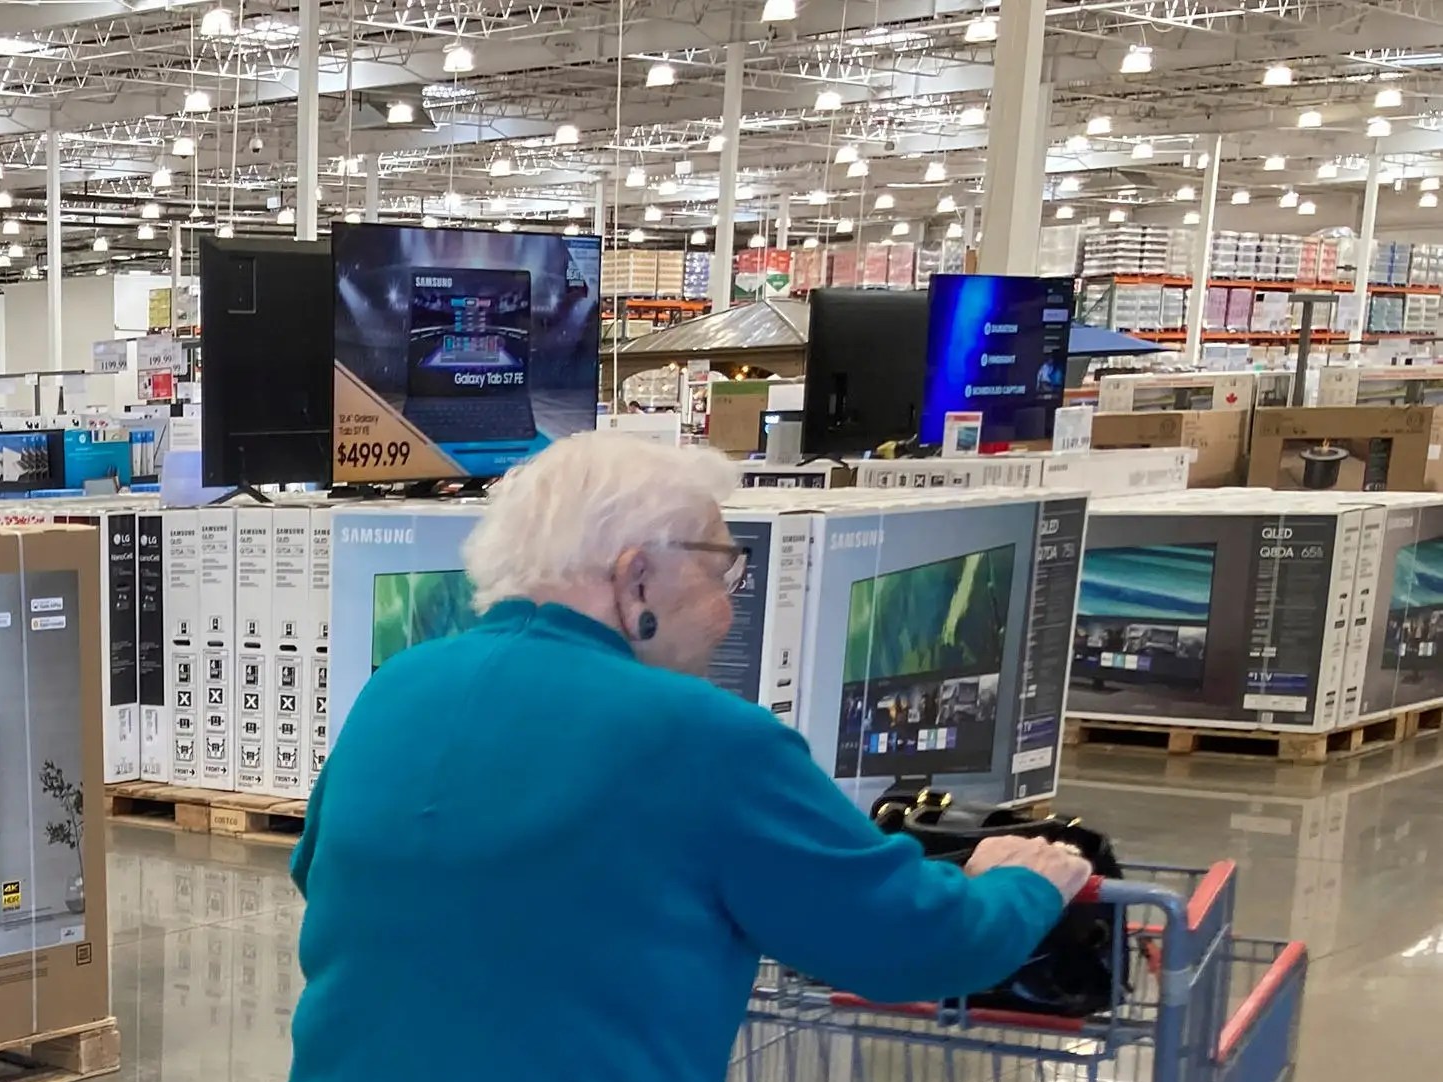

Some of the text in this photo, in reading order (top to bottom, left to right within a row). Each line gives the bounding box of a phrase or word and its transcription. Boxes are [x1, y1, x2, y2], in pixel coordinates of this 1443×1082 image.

[416, 277, 452, 288] SAMSUNG
[454, 372, 524, 388] Galaxy Tab S7 FE
[355, 413, 380, 424] Galaxy
[339, 426, 351, 435] Tab
[337, 441, 410, 468] $499.99
[341, 527, 415, 545] SAMSUNG
[1261, 528, 1294, 540] QLED
[1260, 672, 1273, 682] TV
[214, 816, 238, 826] COSTCO
[4, 883, 19, 893] 4K
[4, 895, 20, 905] HDR
